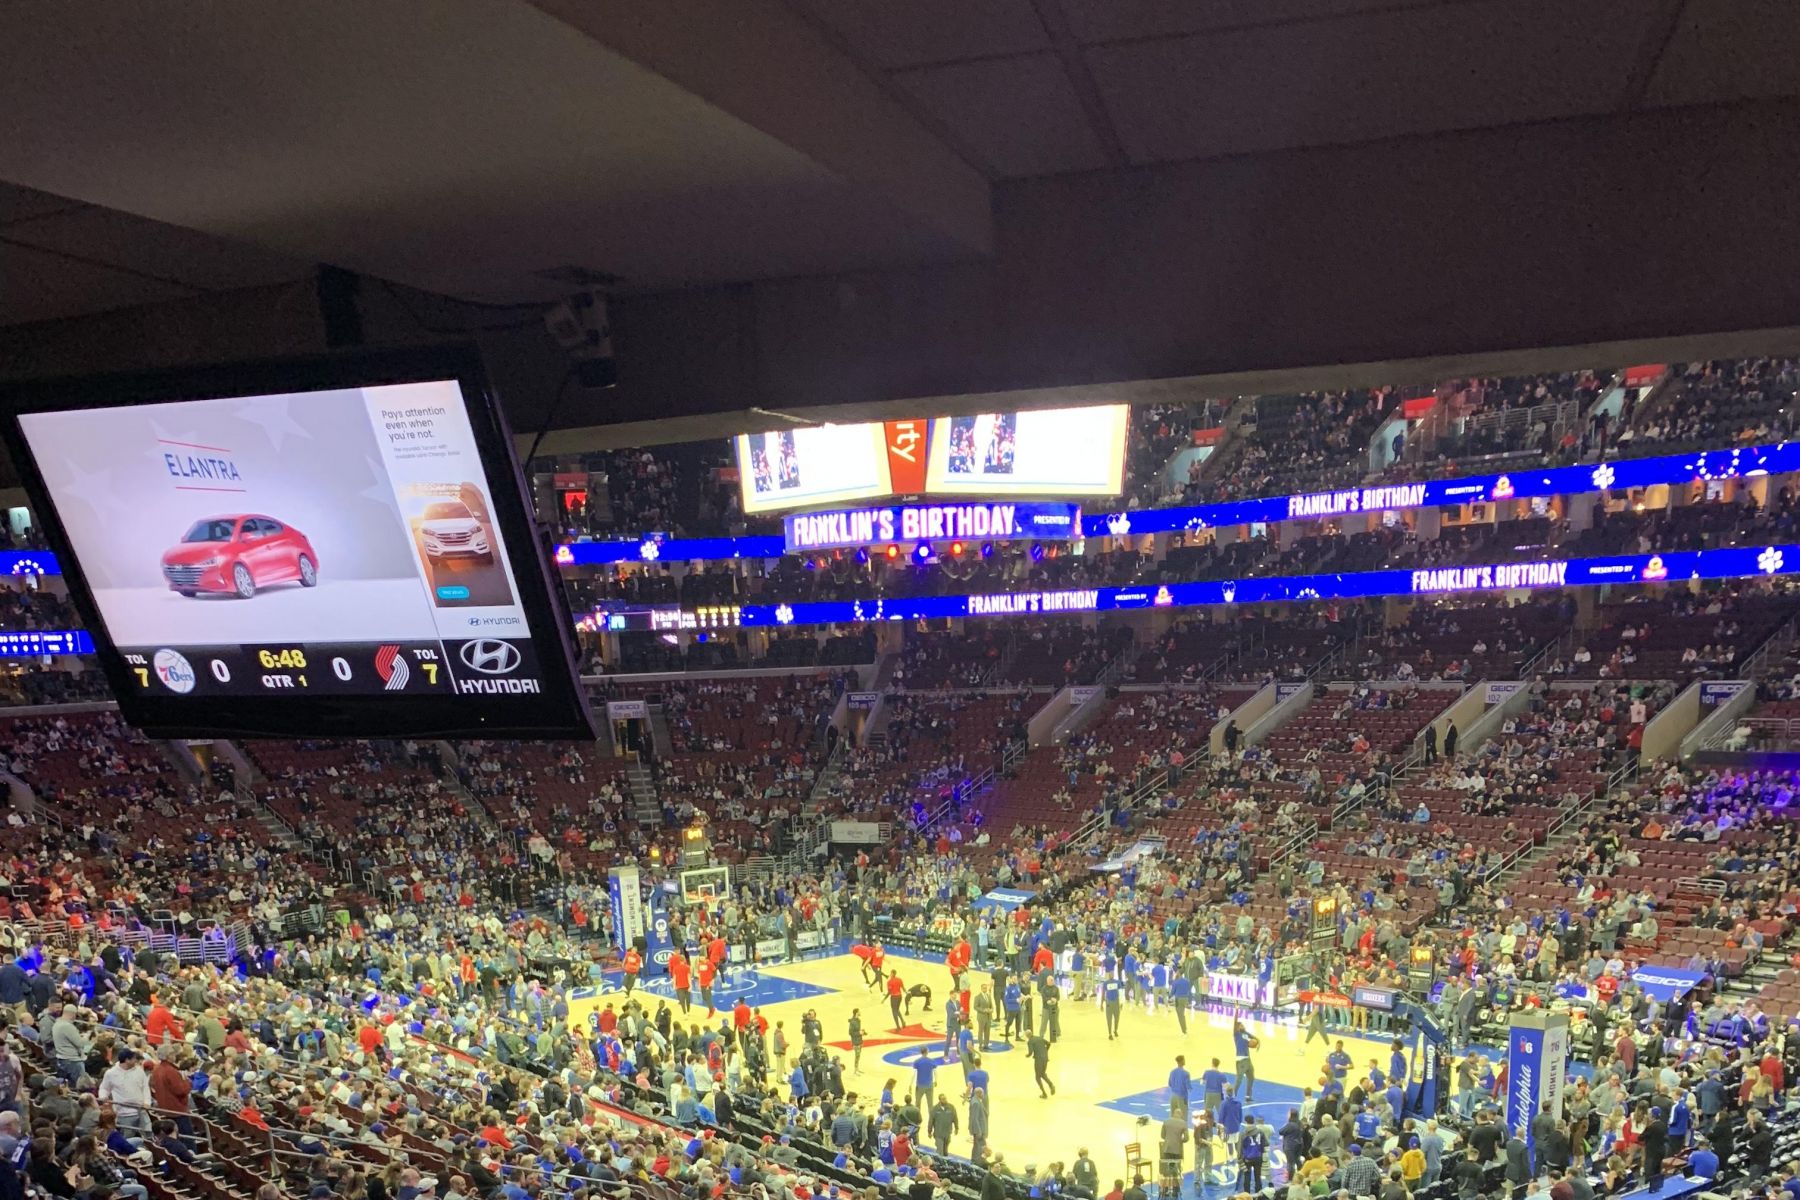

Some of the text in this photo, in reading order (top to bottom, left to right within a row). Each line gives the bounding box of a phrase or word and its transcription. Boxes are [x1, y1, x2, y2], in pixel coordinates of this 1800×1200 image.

[381, 405, 446, 421] Pays attention
[385, 418, 434, 430] even when
[388, 429, 435, 442] you're not.
[164, 453, 242, 480] ELANTRA
[1288, 491, 1359, 517] FRANKLIN'S
[1362, 484, 1427, 510] BIRTHDAY
[793, 509, 894, 547] FRANKLIN'S
[902, 505, 1016, 539] BIRTHDAY
[1412, 566, 1492, 591] FRANKLIN'S
[1495, 561, 1568, 587] BIRTHDAY
[968, 593, 1040, 614] FRANKLIN'S
[1042, 590, 1099, 611] BIRTHDAY
[483, 617, 520, 625] HYUNDAI
[124, 654, 148, 664] TOL
[259, 649, 307, 669] 6:48
[413, 649, 439, 660] TOL
[133, 667, 149, 687] 7
[158, 665, 194, 682] 76ers
[210, 658, 231, 683] 0
[332, 656, 353, 682] 0
[422, 663, 438, 685] 7
[262, 674, 308, 689] QTR 1
[460, 679, 541, 694] HYUNDAI
[1632, 972, 1695, 987] GEICO
[1548, 1060, 1558, 1098] MOMENT
[1250, 1133, 1261, 1146] 14
